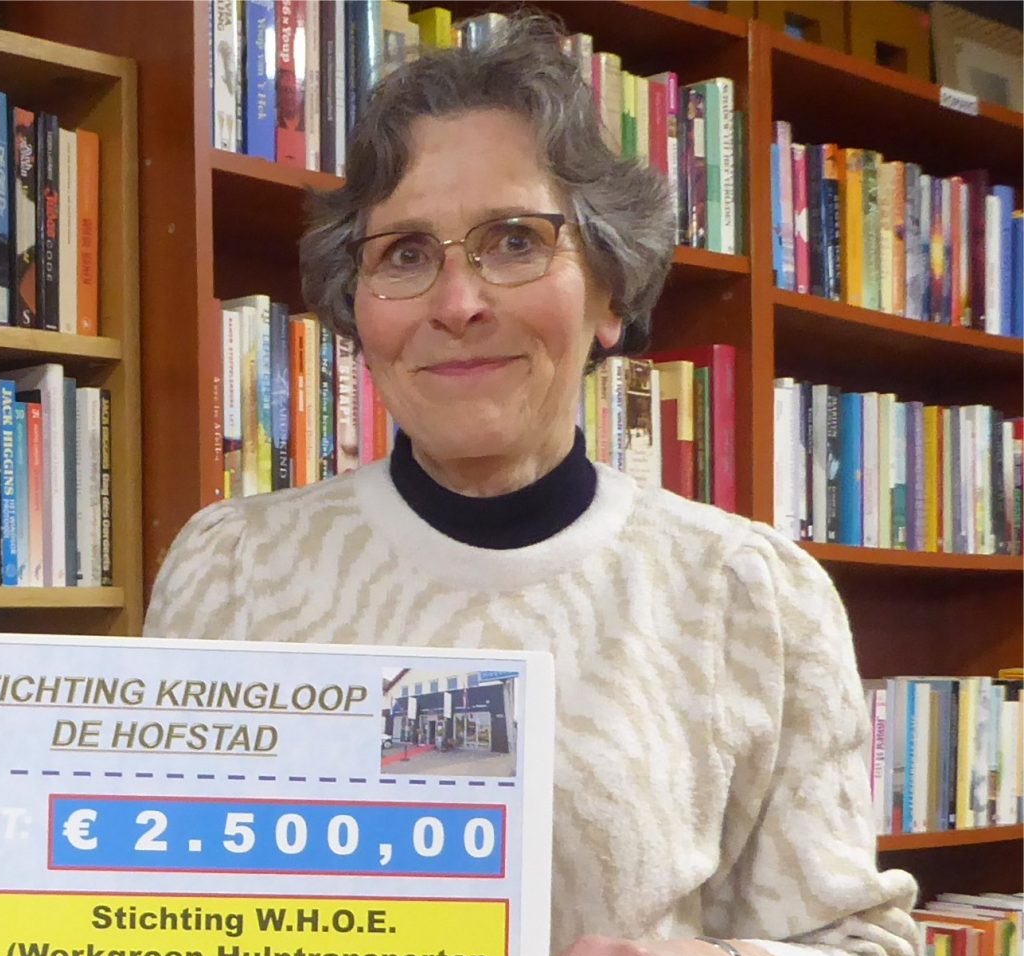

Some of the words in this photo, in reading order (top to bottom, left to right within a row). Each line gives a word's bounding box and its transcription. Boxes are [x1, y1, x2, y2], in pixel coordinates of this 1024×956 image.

[280, 27, 292, 63] Youp
[2, 387, 14, 426] JACK
[338, 364, 352, 425] SLAAPT
[3, 430, 15, 495] HIGGINS
[156, 678, 368, 713] KRINGLOOP
[51, 719, 103, 748] DE
[111, 720, 279, 753] HOFSTAD
[62, 807, 98, 851] €
[91, 905, 244, 937] Stichting
[256, 908, 397, 934] W.H.O.E.
